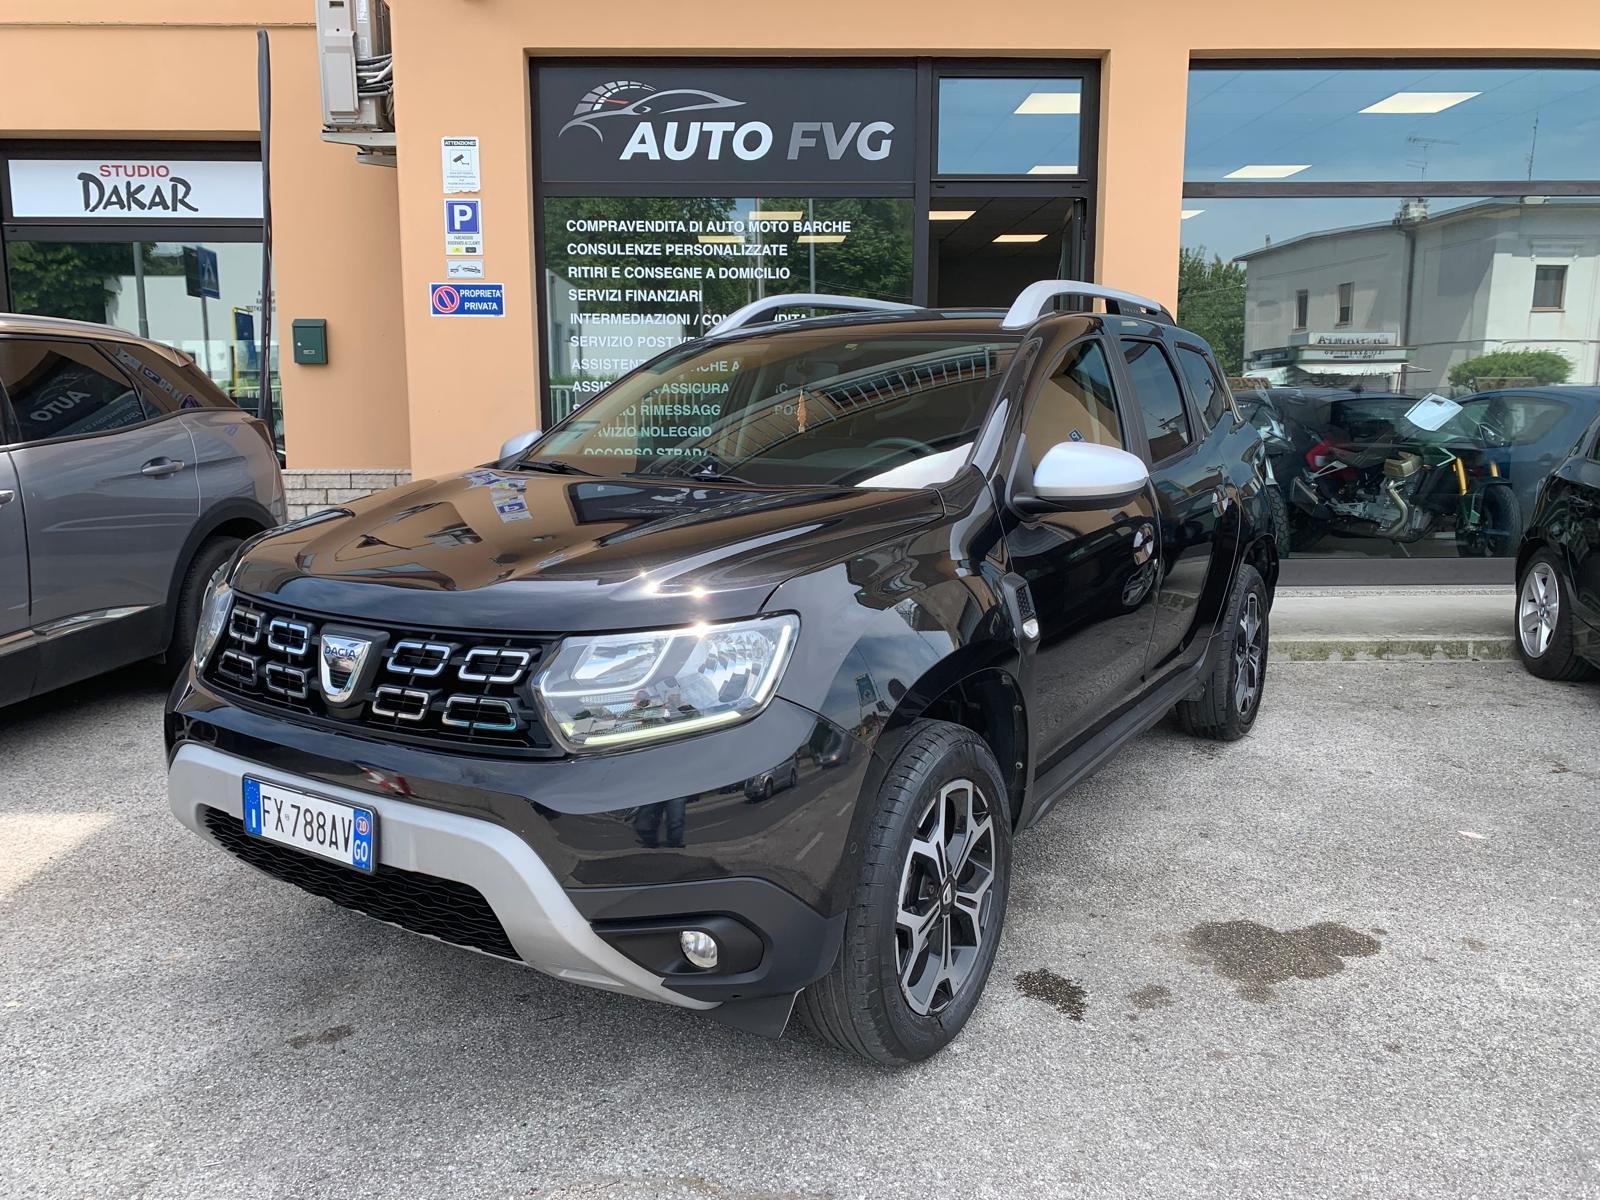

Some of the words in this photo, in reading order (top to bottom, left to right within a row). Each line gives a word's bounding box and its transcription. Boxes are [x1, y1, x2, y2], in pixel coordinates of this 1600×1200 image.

[619, 121, 773, 161] AUTO
[787, 121, 895, 161] FVG
[100, 165, 170, 177] STUDIO
[77, 172, 199, 212] DAKAR
[453, 204, 473, 230] P
[566, 220, 686, 232] COMPRAVENDITA
[689, 221, 703, 232] DI
[706, 221, 745, 233] AUTO
[748, 221, 789, 233] MOTO
[793, 221, 851, 233] BARCHE
[567, 243, 662, 256] CONSULENZE
[665, 244, 788, 256] PERSONALIZZATE
[568, 266, 608, 278] RITIRI
[611, 266, 621, 278] E
[624, 266, 702, 279] CONSEGNE
[705, 267, 716, 279] A
[719, 267, 790, 279] DOMICILIO
[568, 289, 622, 302] SERVIZI
[625, 289, 703, 302] FINANZIARI
[464, 301, 499, 310] PRIVATA
[570, 313, 690, 325] INTERMEDIAZIONI
[570, 336, 634, 348] SERVIZIO
[637, 336, 674, 348] POST
[571, 359, 646, 370] ASSISTEN
[640, 404, 721, 416] RIMESSAGG
[641, 426, 712, 438] NOLEGGIO
[324, 645, 356, 659] DACIA
[353, 839, 369, 862] GO
